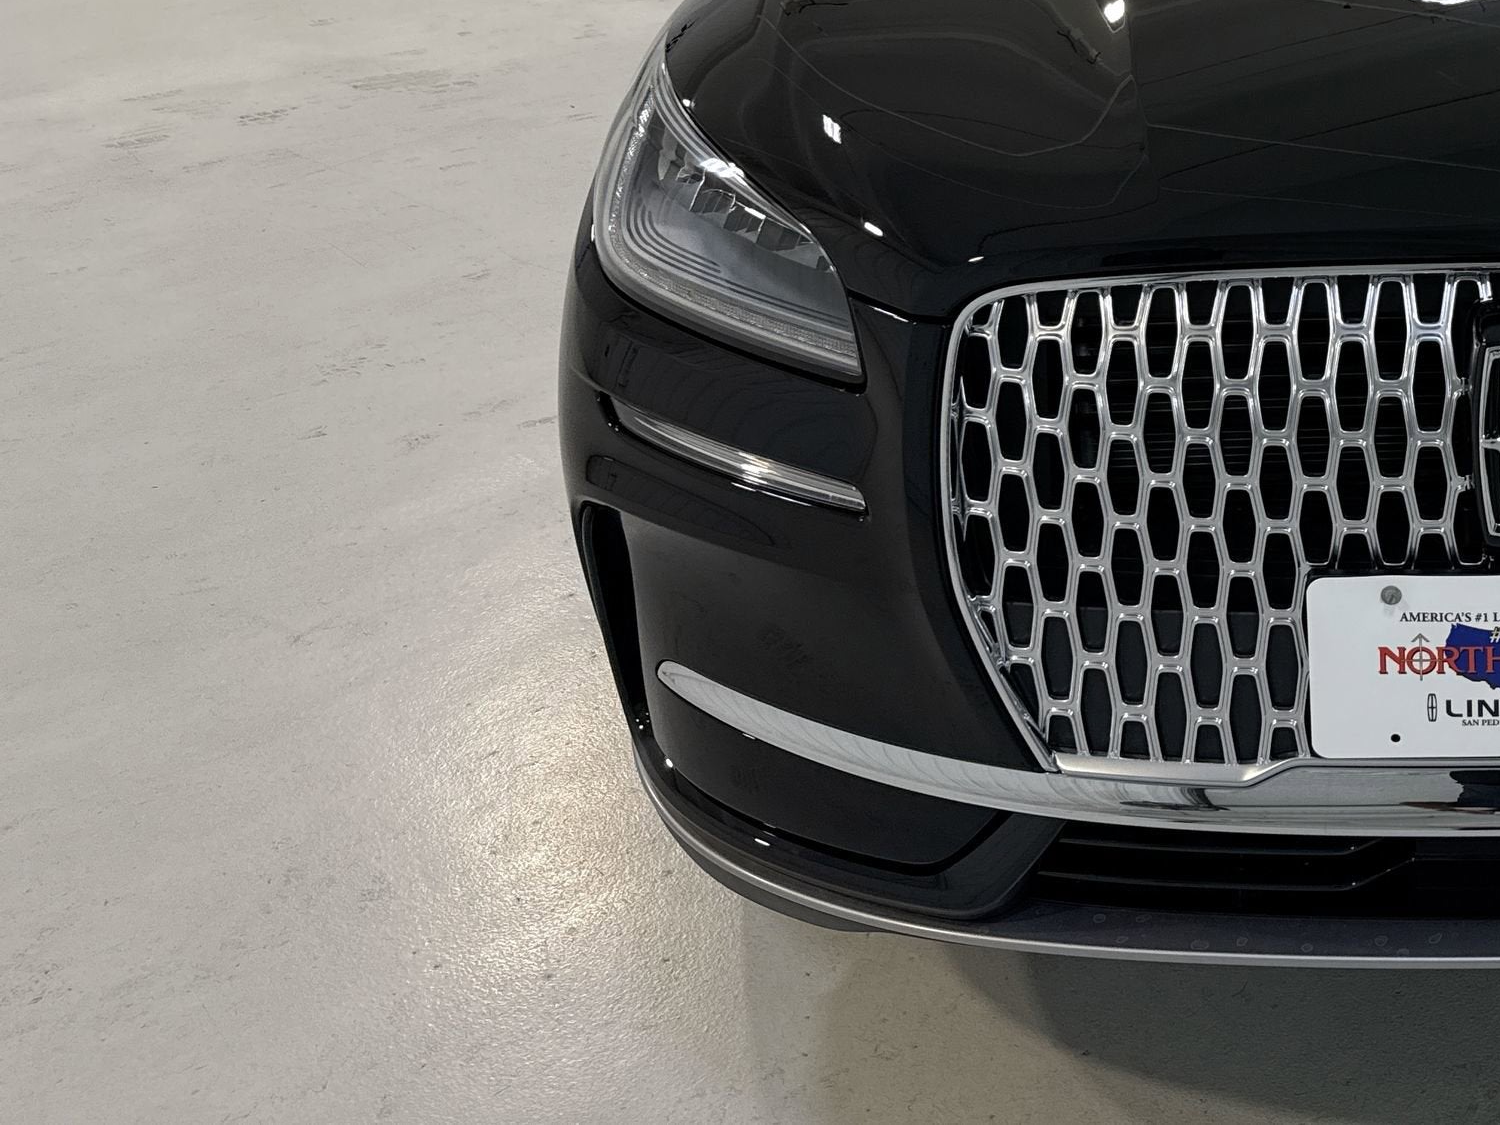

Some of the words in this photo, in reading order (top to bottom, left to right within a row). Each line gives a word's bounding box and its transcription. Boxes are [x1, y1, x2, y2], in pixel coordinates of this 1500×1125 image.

[1400, 612, 1472, 623] AMERICA'S
[1475, 613, 1489, 623] #1
[1462, 718, 1480, 727] SAN
